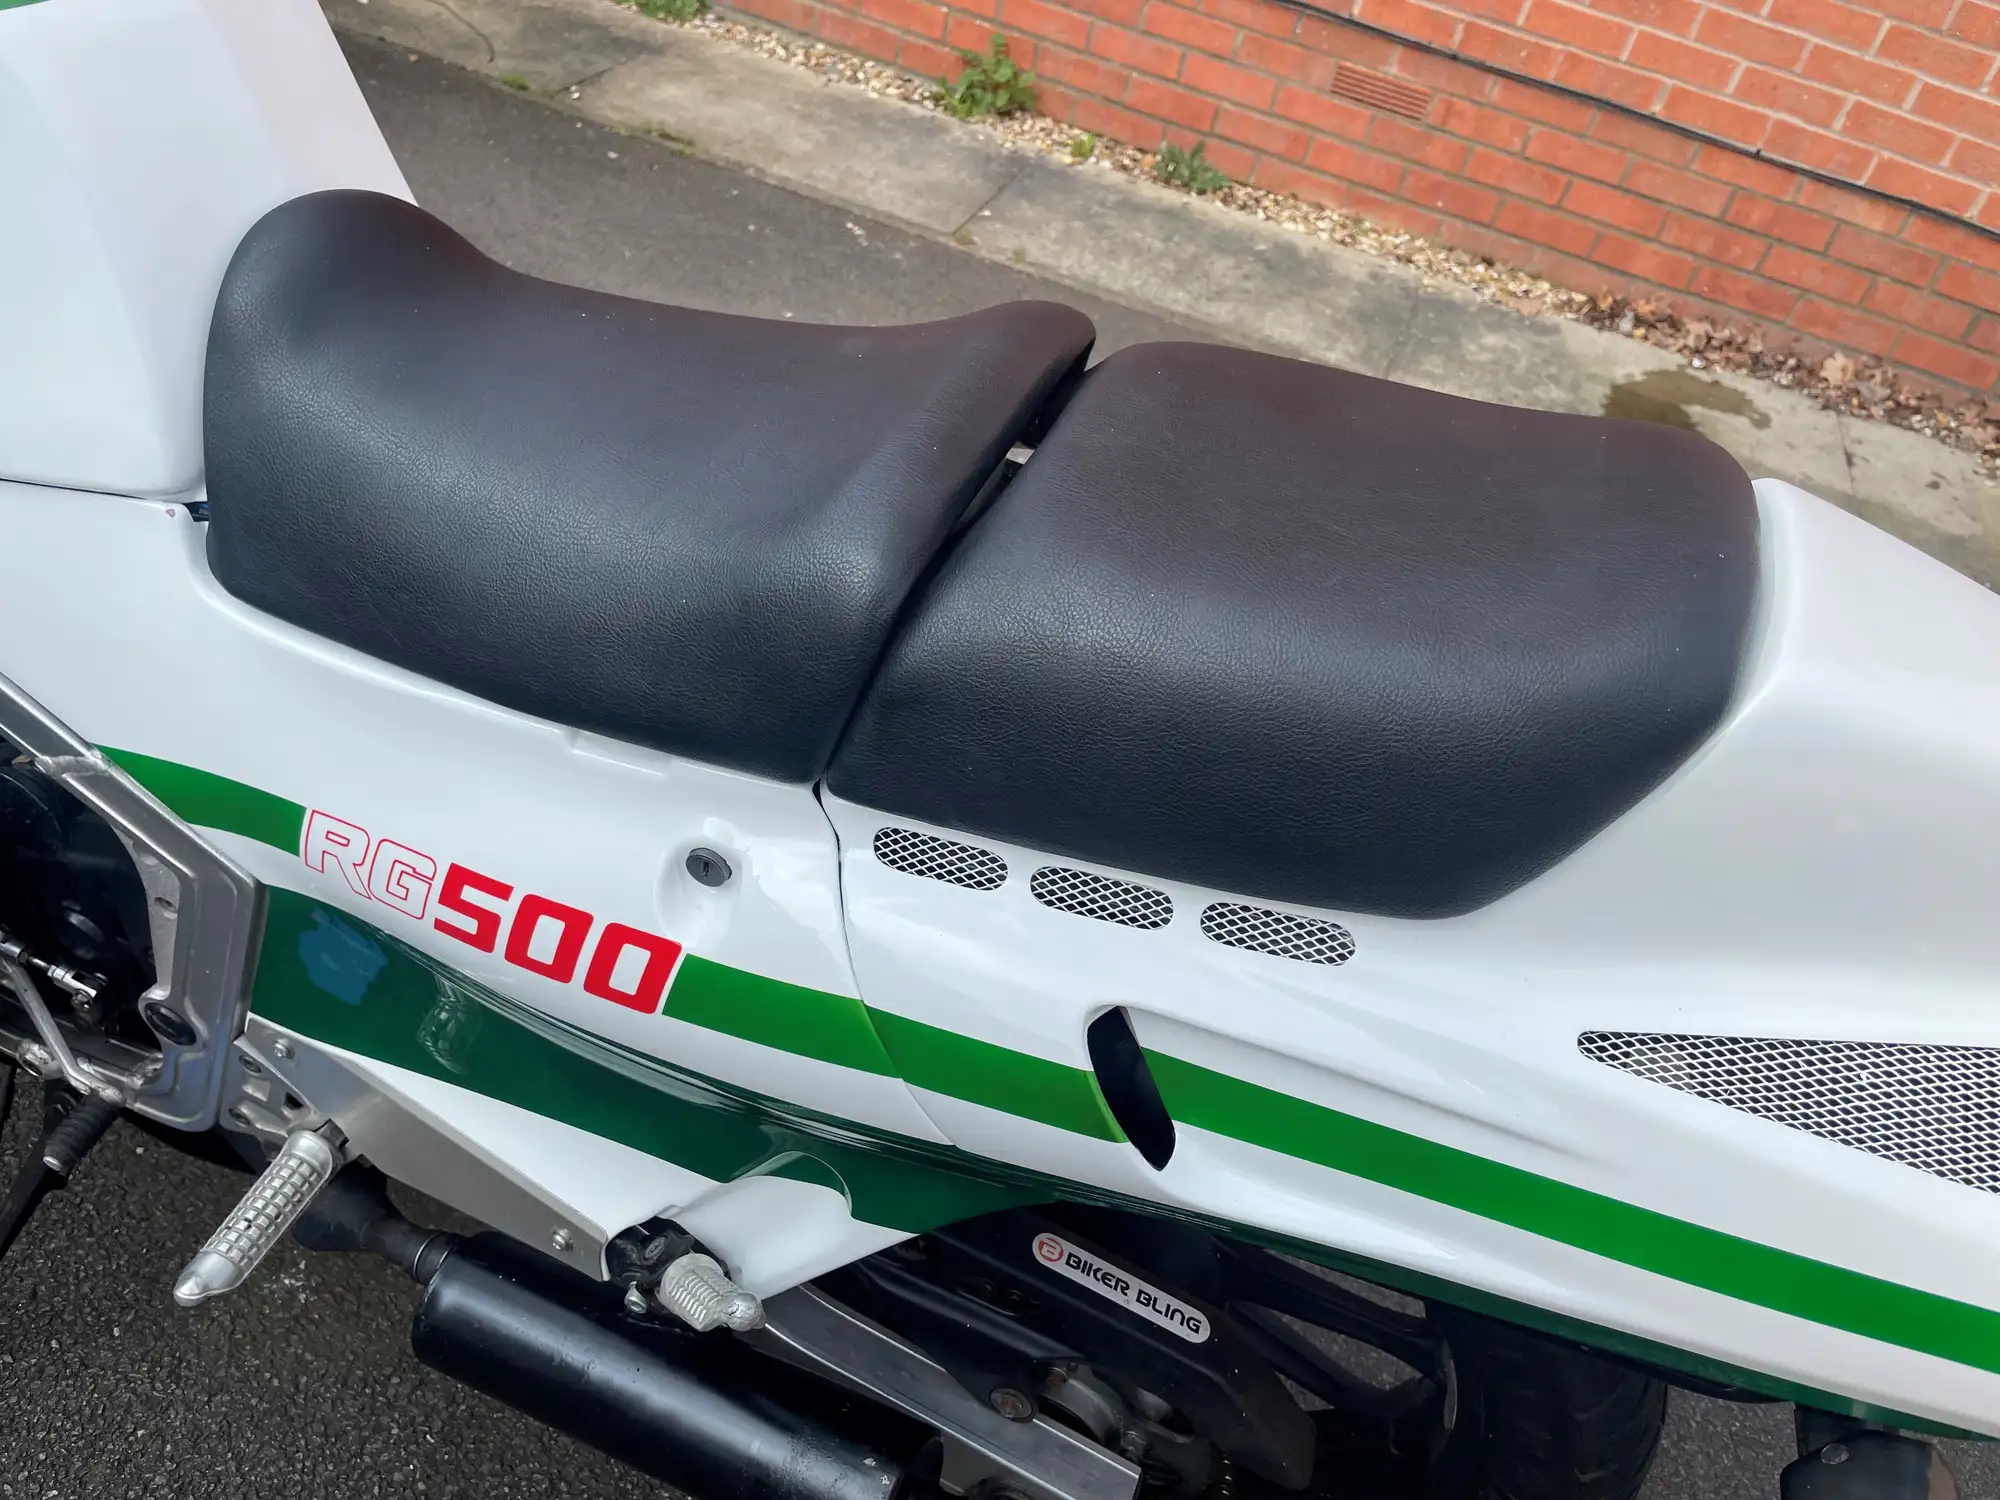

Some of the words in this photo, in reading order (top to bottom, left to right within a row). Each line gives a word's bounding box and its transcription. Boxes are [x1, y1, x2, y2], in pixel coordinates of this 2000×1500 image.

[305, 809, 683, 1014] RG500
[1065, 1252, 1130, 1297] BIKER
[1136, 1288, 1202, 1335] BLING
